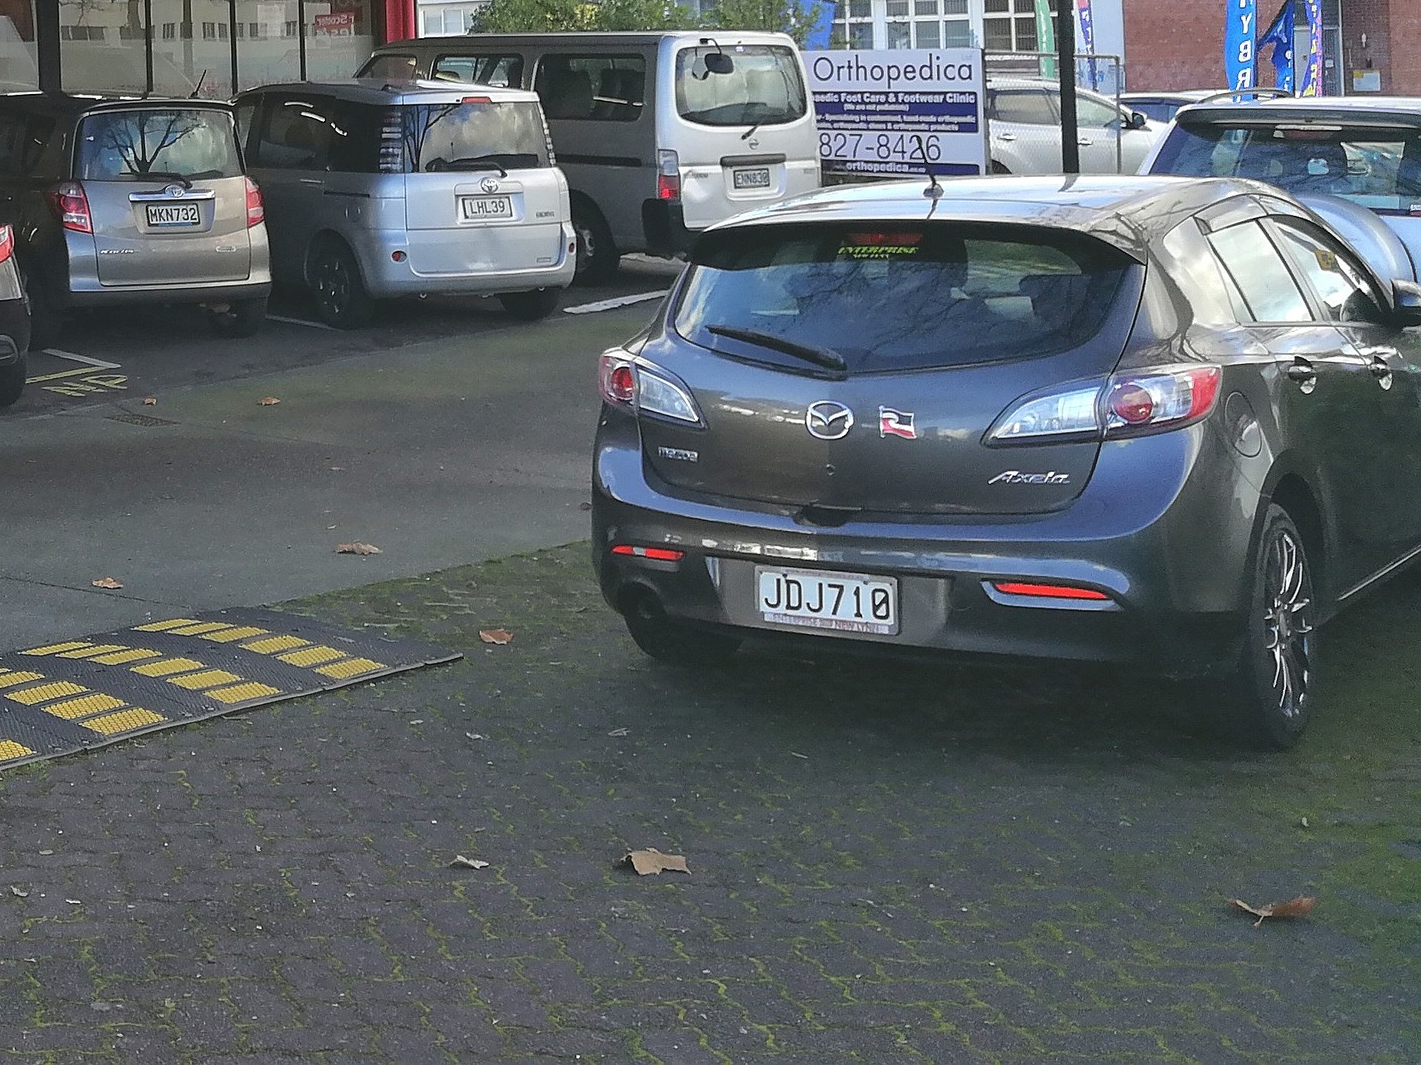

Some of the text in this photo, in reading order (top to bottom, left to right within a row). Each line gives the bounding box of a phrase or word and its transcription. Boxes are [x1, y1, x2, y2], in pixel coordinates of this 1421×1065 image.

[813, 53, 973, 89] Orthopedica
[812, 92, 975, 103] aedic Foot Care & Footwear Clinic
[819, 133, 941, 160] 827-8426
[470, 201, 505, 214] LHL39
[150, 208, 197, 222] MKN732
[988, 471, 1070, 484] Axela
[765, 578, 889, 620] JDJ710
